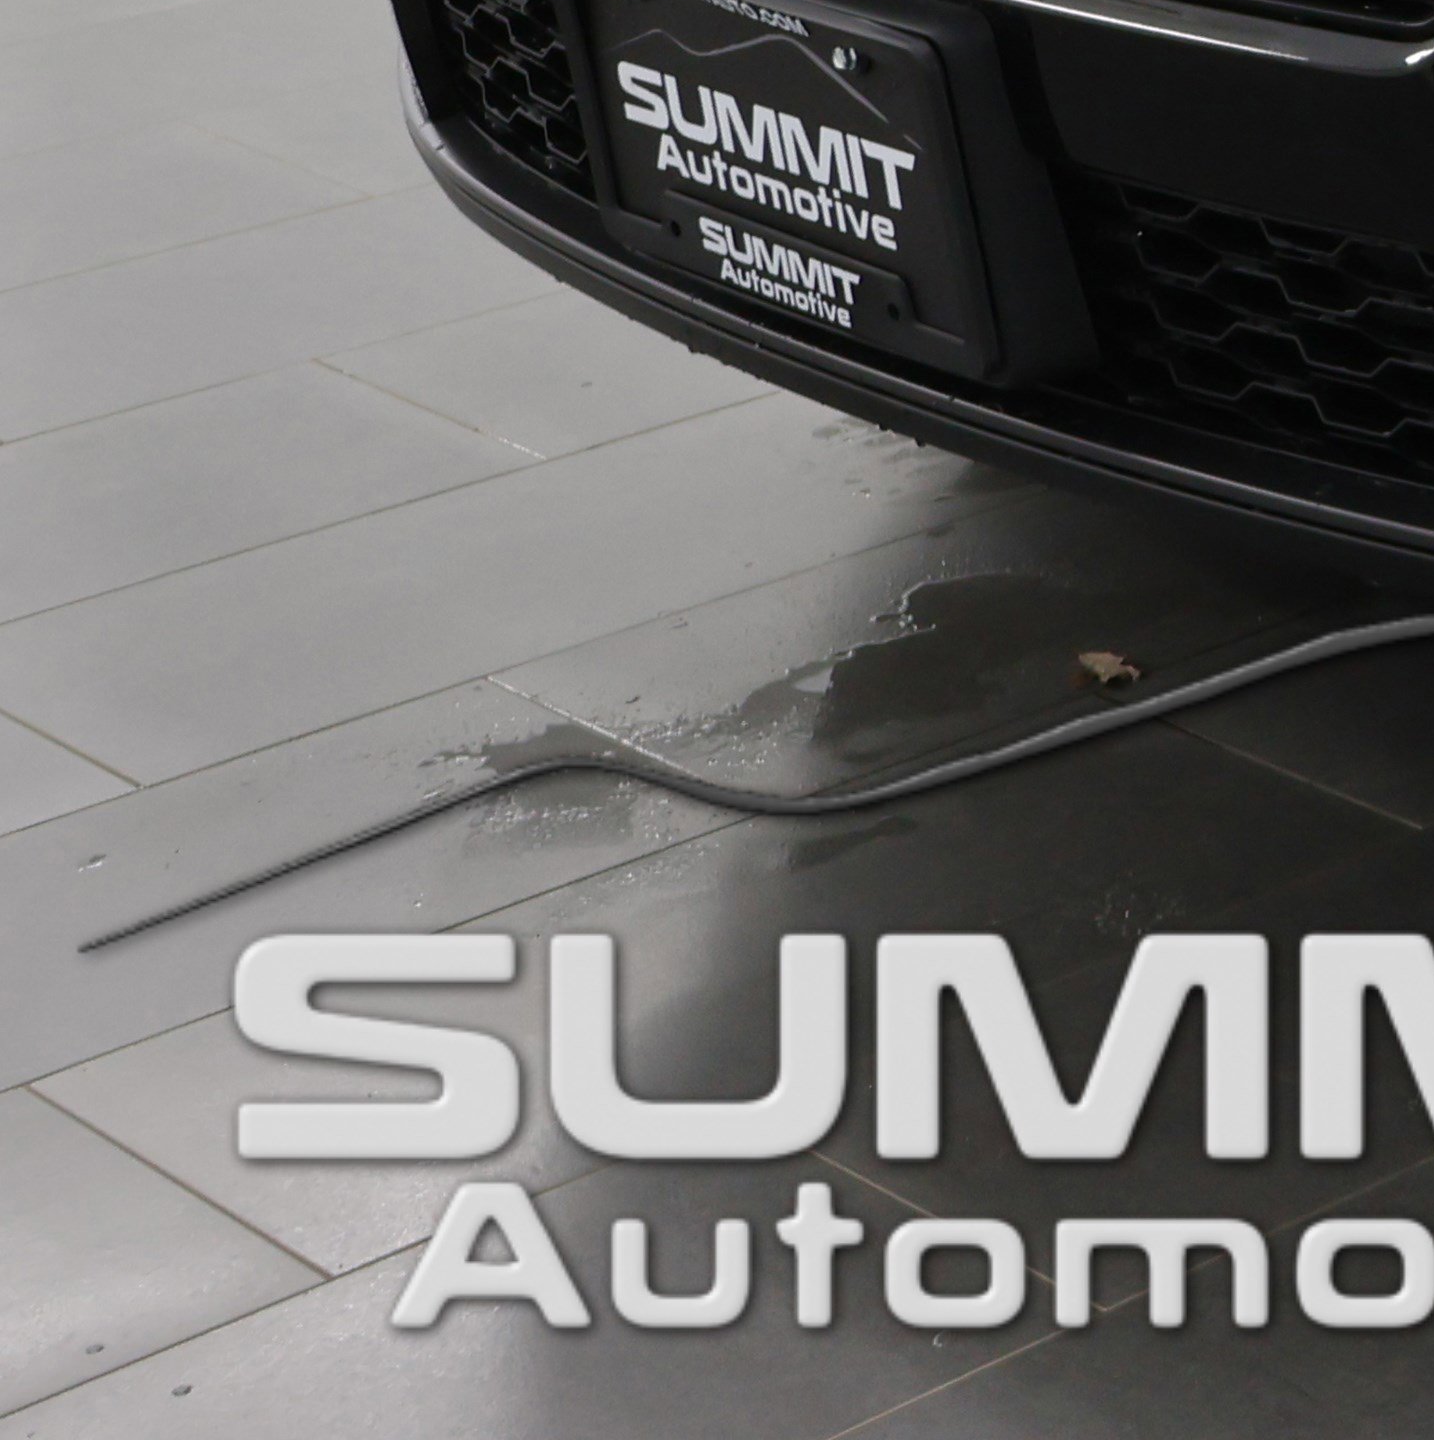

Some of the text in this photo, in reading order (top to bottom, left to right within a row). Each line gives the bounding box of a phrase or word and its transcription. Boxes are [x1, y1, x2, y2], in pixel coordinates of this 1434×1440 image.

[616, 59, 916, 211] SUMMIT
[656, 133, 899, 252] Automotive
[697, 215, 861, 306] SUMMIT
[719, 260, 853, 329] Automotive
